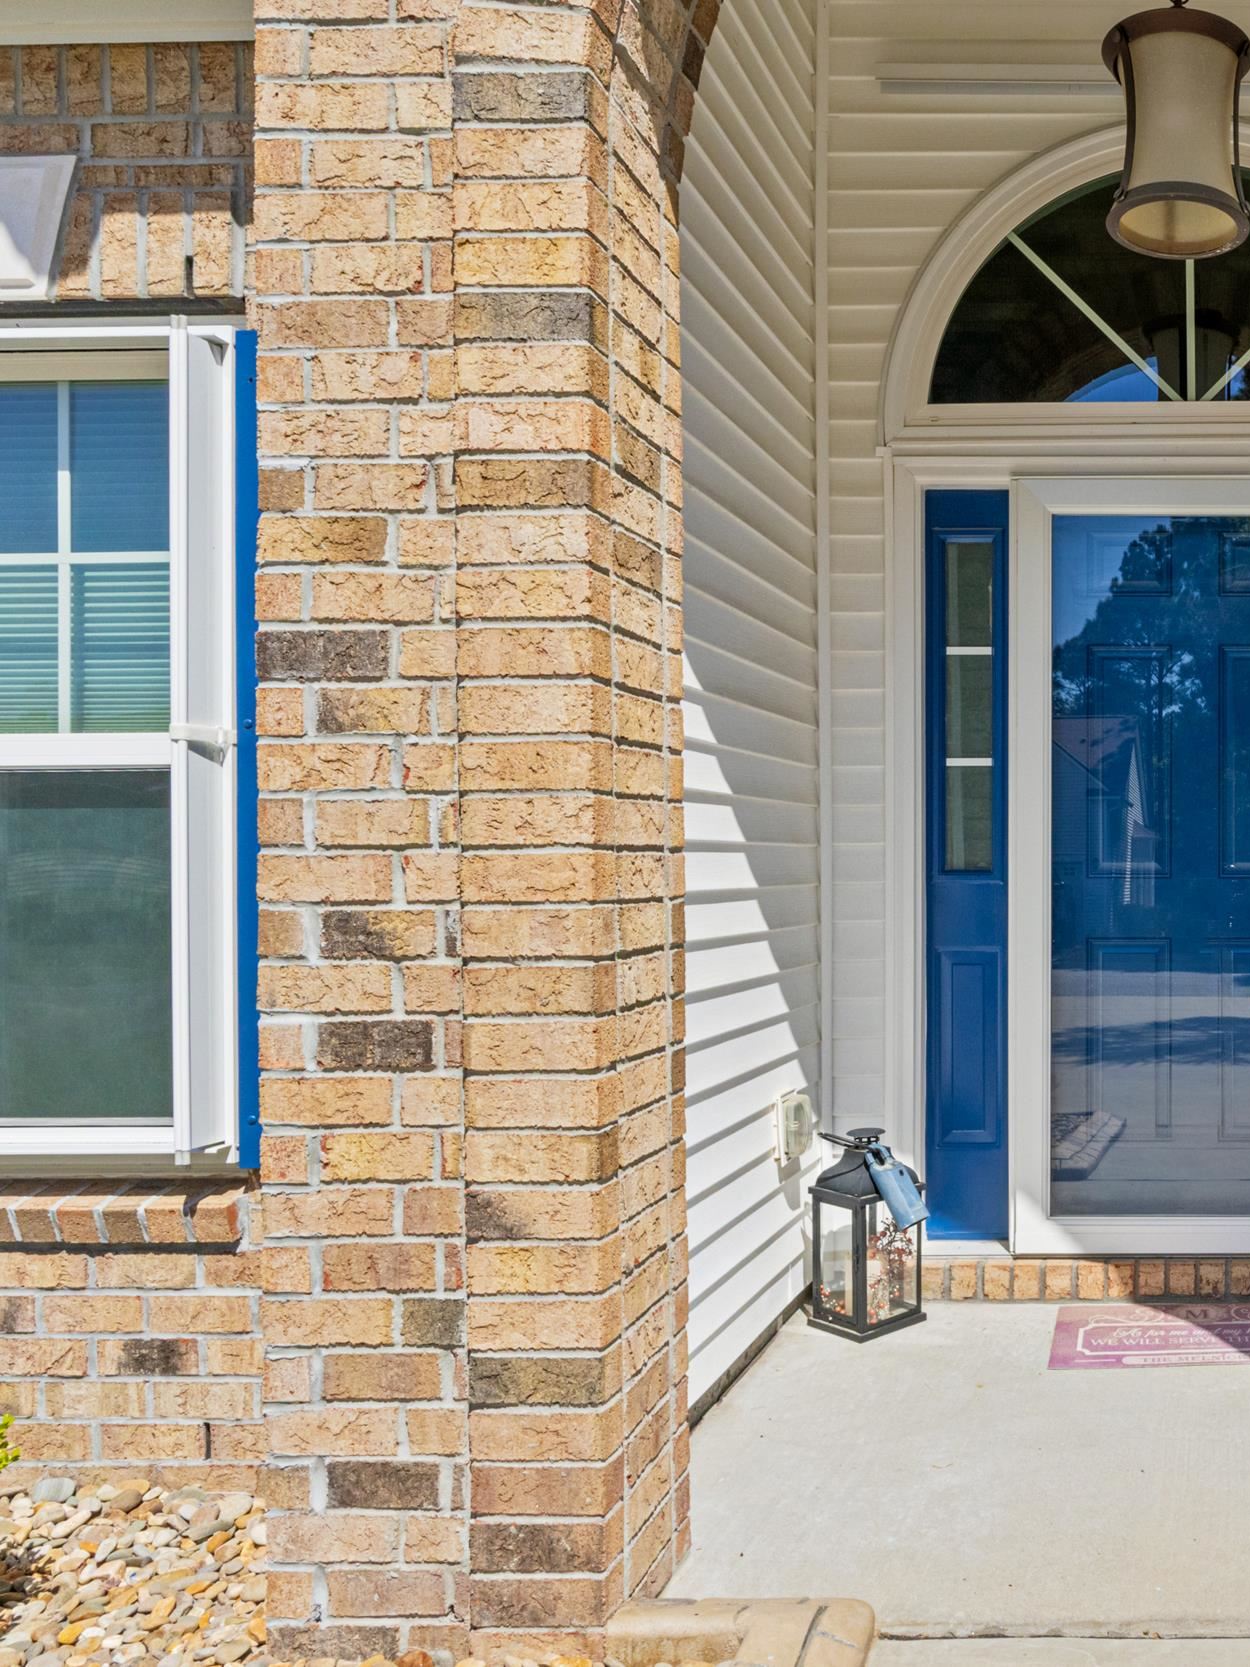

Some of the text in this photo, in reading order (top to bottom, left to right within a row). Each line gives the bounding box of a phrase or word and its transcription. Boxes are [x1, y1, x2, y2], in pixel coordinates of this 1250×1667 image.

[1185, 1309, 1209, 1319] M
[1091, 1338, 1119, 1346] WE
[1122, 1337, 1164, 1345] WILL
